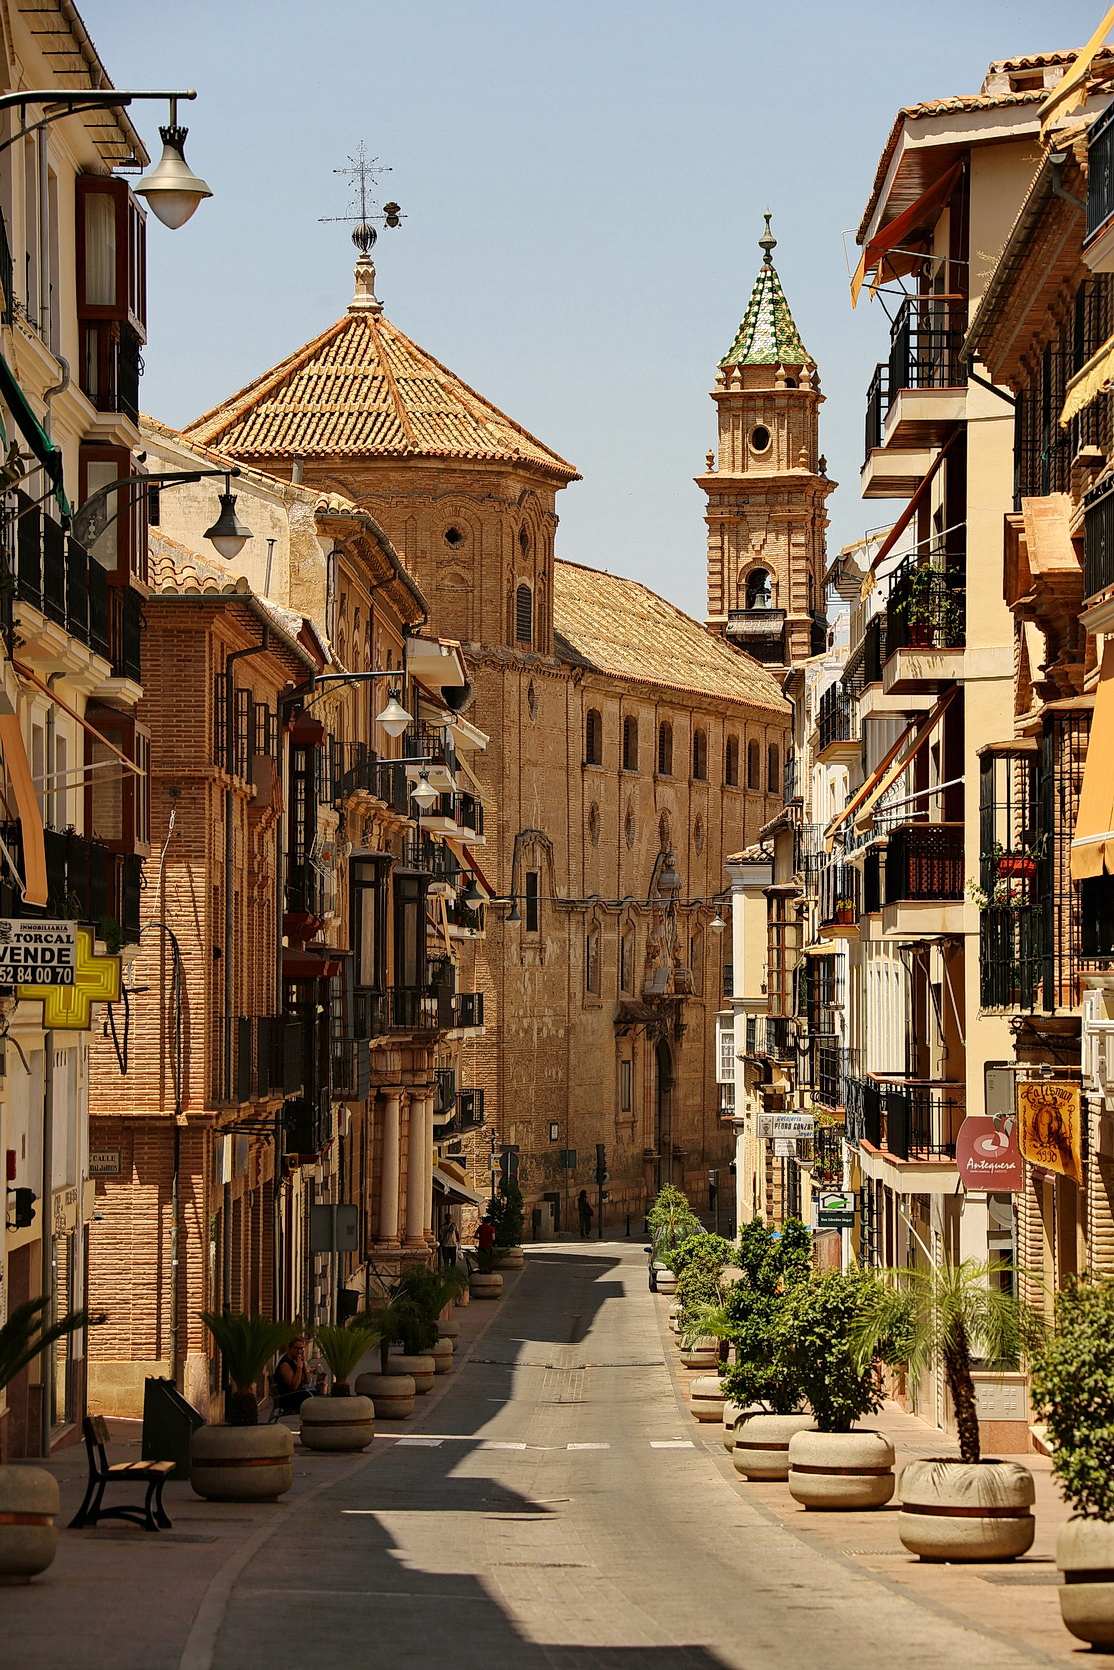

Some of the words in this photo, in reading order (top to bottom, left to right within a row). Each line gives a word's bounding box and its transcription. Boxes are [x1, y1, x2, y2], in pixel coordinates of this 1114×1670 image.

[14, 933, 75, 944] TORCAL
[0, 946, 71, 965] VENDE
[17, 967, 32, 983] 84
[36, 967, 52, 983] 00
[55, 967, 72, 984] 70
[966, 1156, 1016, 1174] Antequera
